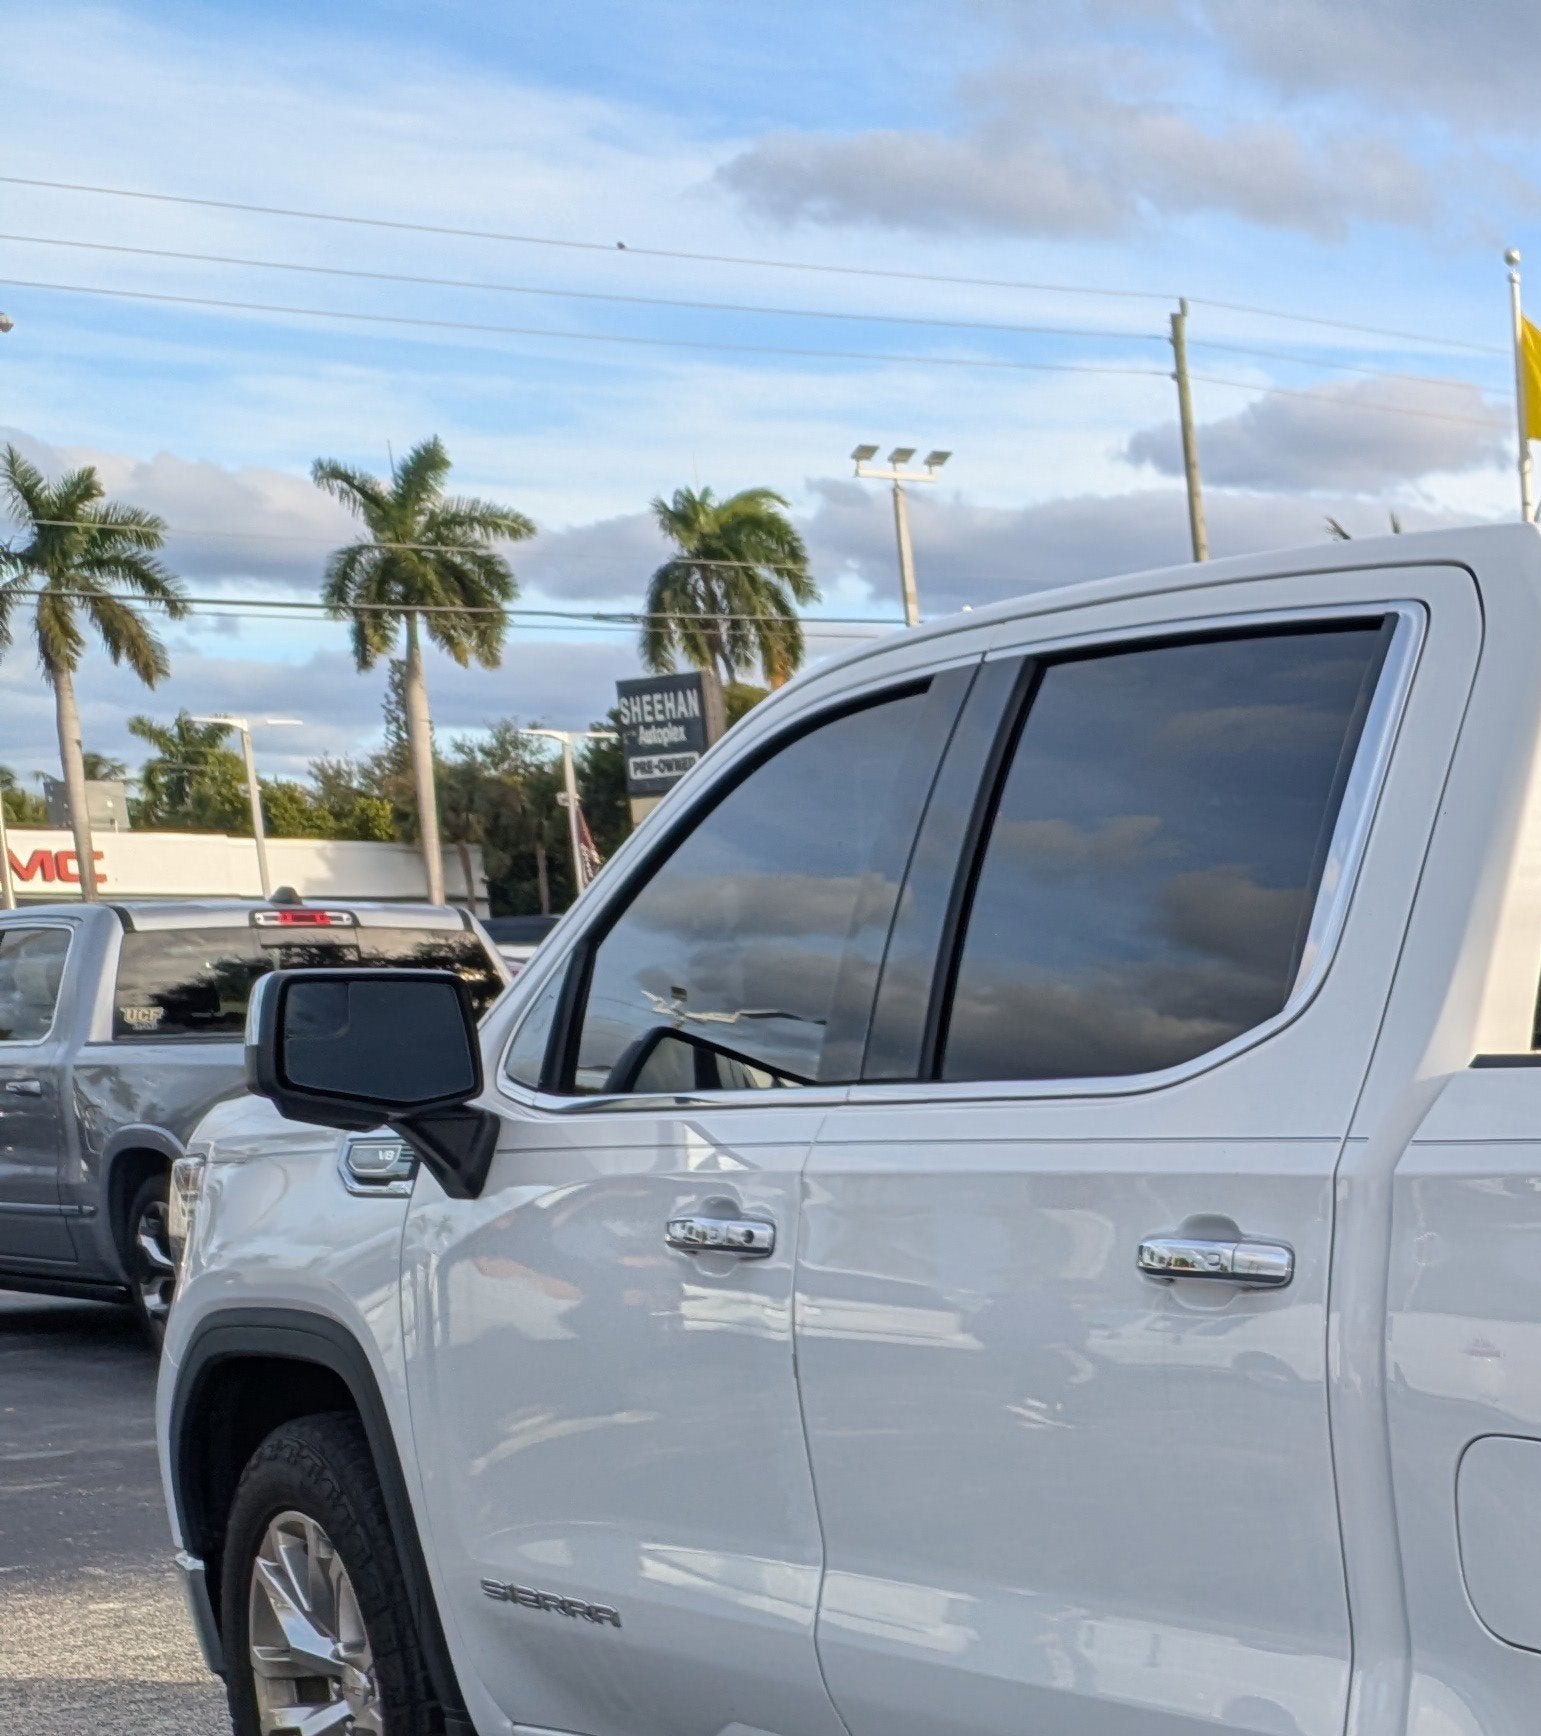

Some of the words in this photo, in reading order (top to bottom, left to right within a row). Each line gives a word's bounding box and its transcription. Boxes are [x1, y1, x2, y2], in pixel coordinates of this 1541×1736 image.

[619, 688, 700, 725] SHEEHAN
[123, 1007, 164, 1023] UCF
[480, 1577, 622, 1629] SIERRA
